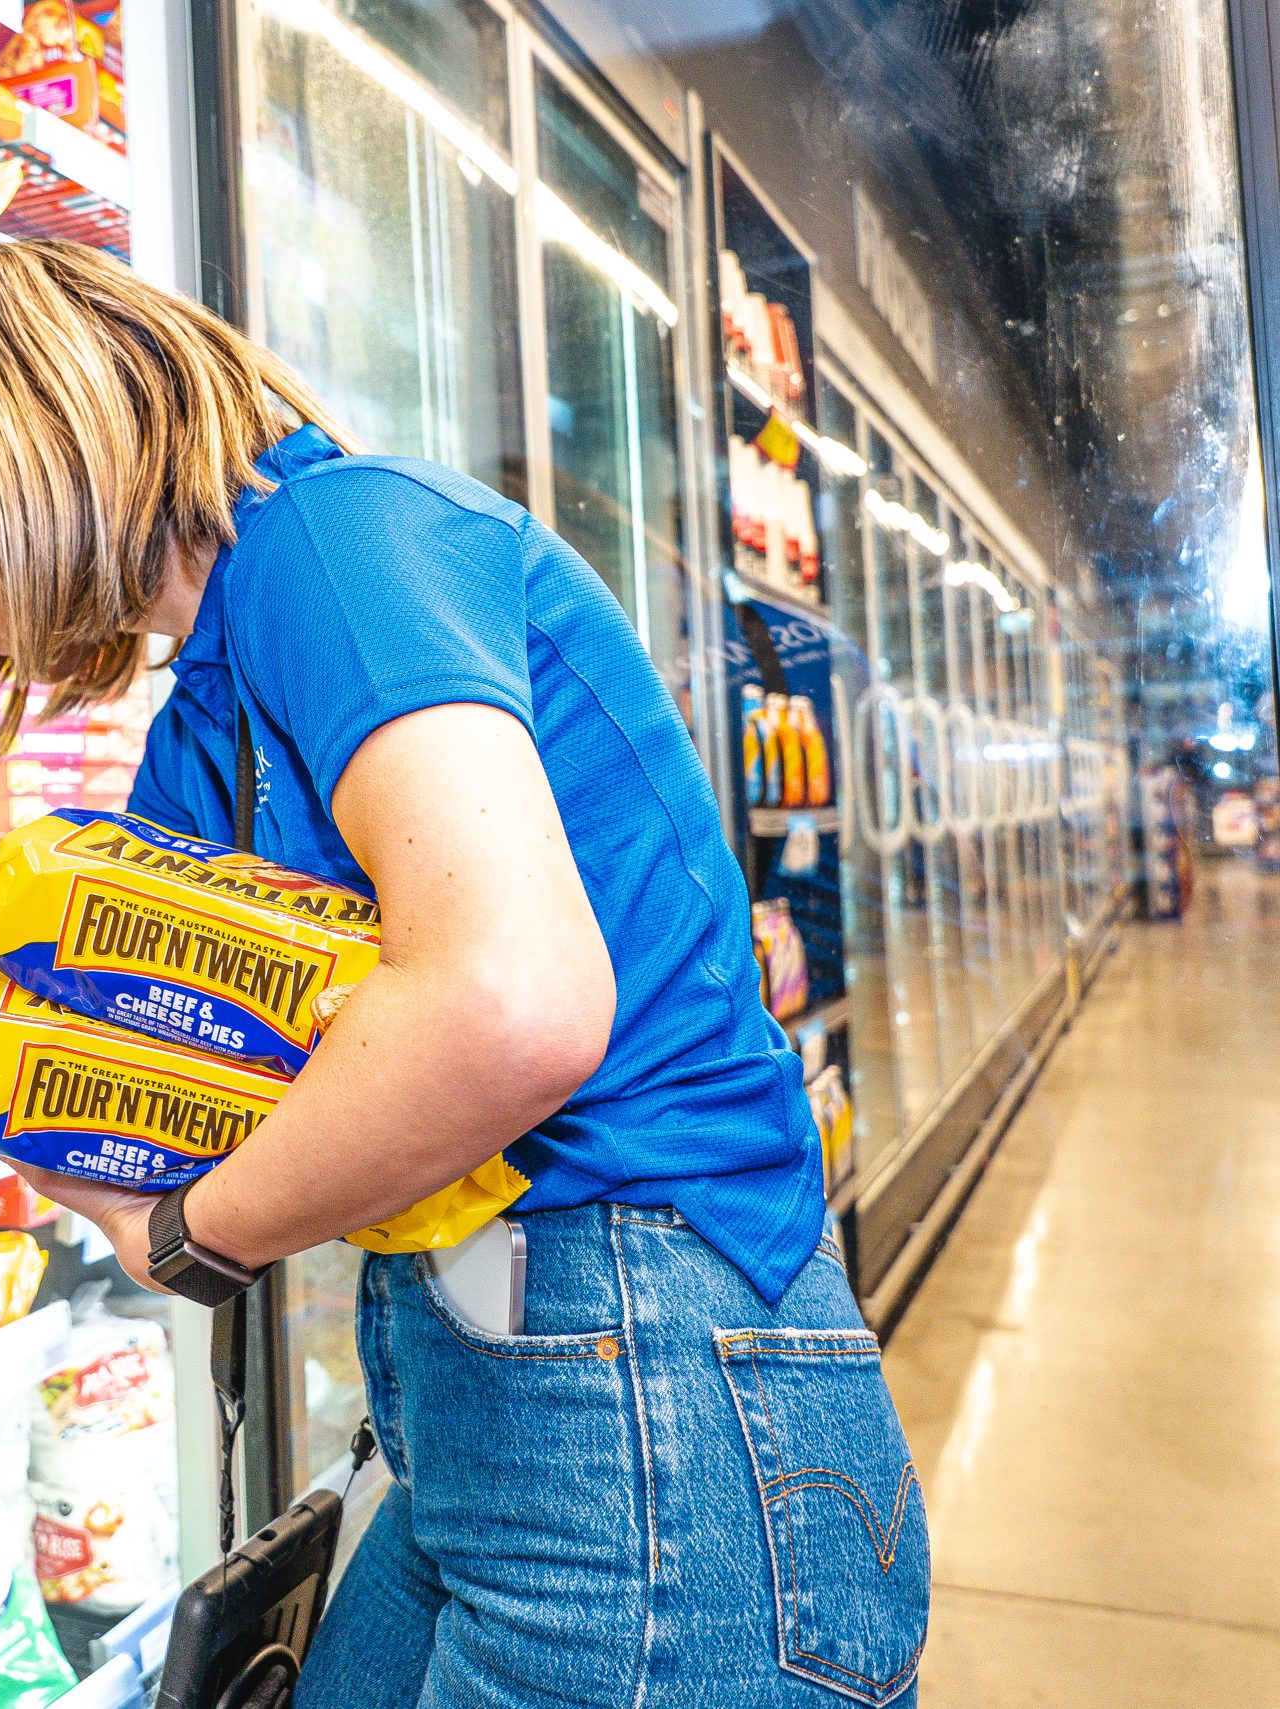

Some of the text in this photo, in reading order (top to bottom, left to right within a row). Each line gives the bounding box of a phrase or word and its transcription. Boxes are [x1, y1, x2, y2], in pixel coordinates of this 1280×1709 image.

[119, 899, 284, 959] THE GREAT AUSTRALIAN TASTE
[191, 934, 321, 1029] TWENTY
[115, 992, 246, 1050] CHEESE PIES
[148, 985, 214, 1021] BEEF &
[106, 1006, 116, 1014] THE
[116, 1008, 133, 1019] GREAT
[133, 1013, 147, 1023] TASTE
[148, 1018, 156, 1026] OF
[170, 1026, 200, 1043] AUSTRALIAN
[114, 1014, 141, 1028] DELICIOUS
[141, 1022, 157, 1034] GRAVY
[68, 1061, 233, 1109] THE GREAT AUSTRALIAN TASTE
[56, 1164, 66, 1172] THE
[67, 1166, 83, 1175] GREAT
[84, 1169, 98, 1179] TASTE
[66, 1150, 148, 1180] CHEESE
[100, 1139, 150, 1165] BEEF
[151, 1153, 167, 1169] &
[161, 1177, 176, 1185] FLAKY
